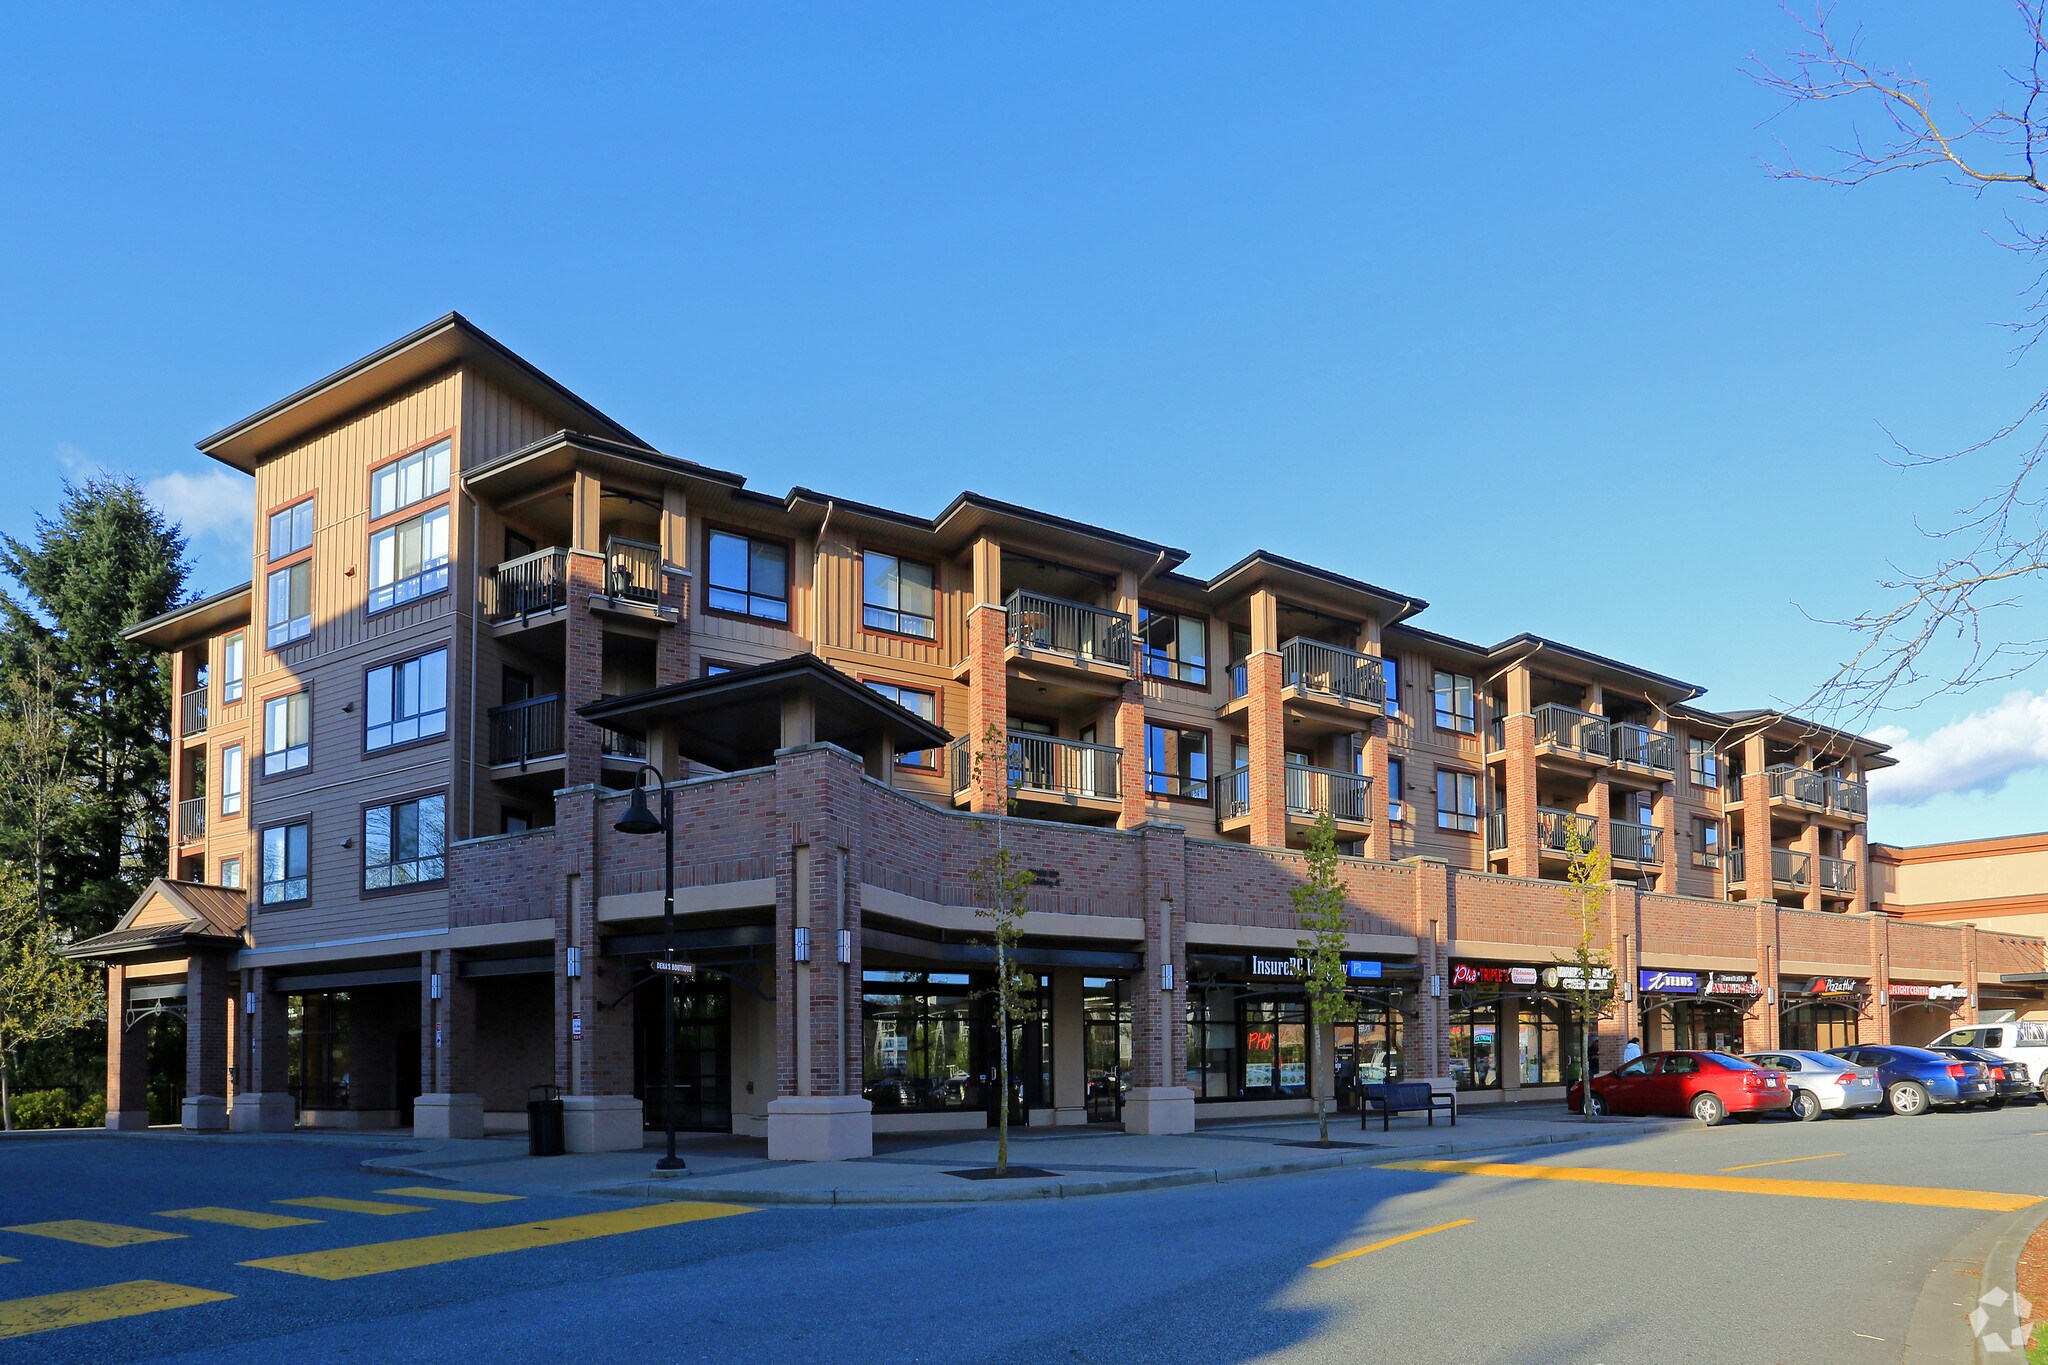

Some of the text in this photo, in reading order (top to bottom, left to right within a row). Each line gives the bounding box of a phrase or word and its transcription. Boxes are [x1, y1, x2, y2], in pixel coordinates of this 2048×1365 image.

[1665, 976, 1694, 987] TELUS
[1825, 979, 1843, 992] Pizza
[1892, 985, 1910, 995] FLIGHT
[1910, 985, 1929, 995] CENTRE
